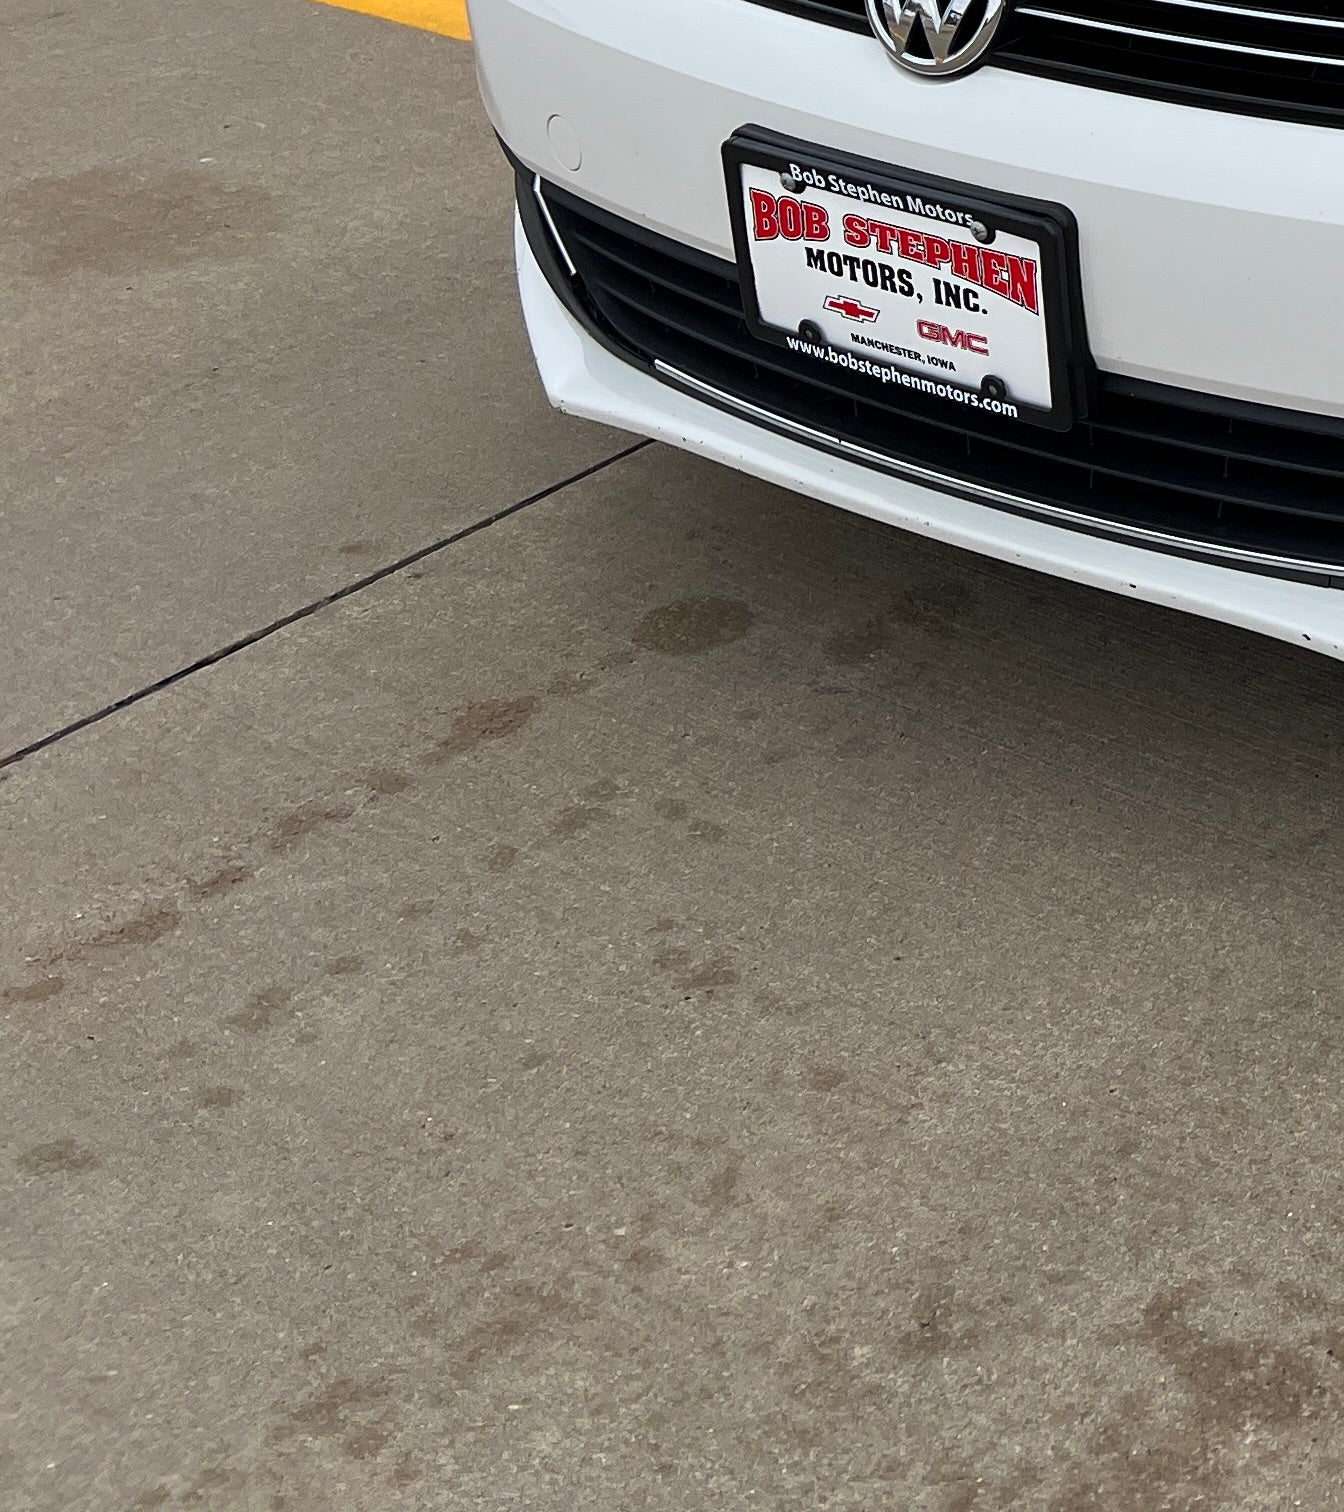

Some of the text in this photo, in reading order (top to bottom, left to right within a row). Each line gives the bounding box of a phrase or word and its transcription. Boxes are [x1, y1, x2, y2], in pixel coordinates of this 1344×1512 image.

[789, 163, 974, 226] Bob Stephen Motors
[750, 187, 1040, 316] BOB STEPHEN
[805, 246, 988, 315] MOTORS, INC.
[850, 332, 957, 372] MANCHESTER, IOWA
[916, 319, 989, 356] GMC
[786, 335, 1018, 418] www.bobstephenmotors.com
